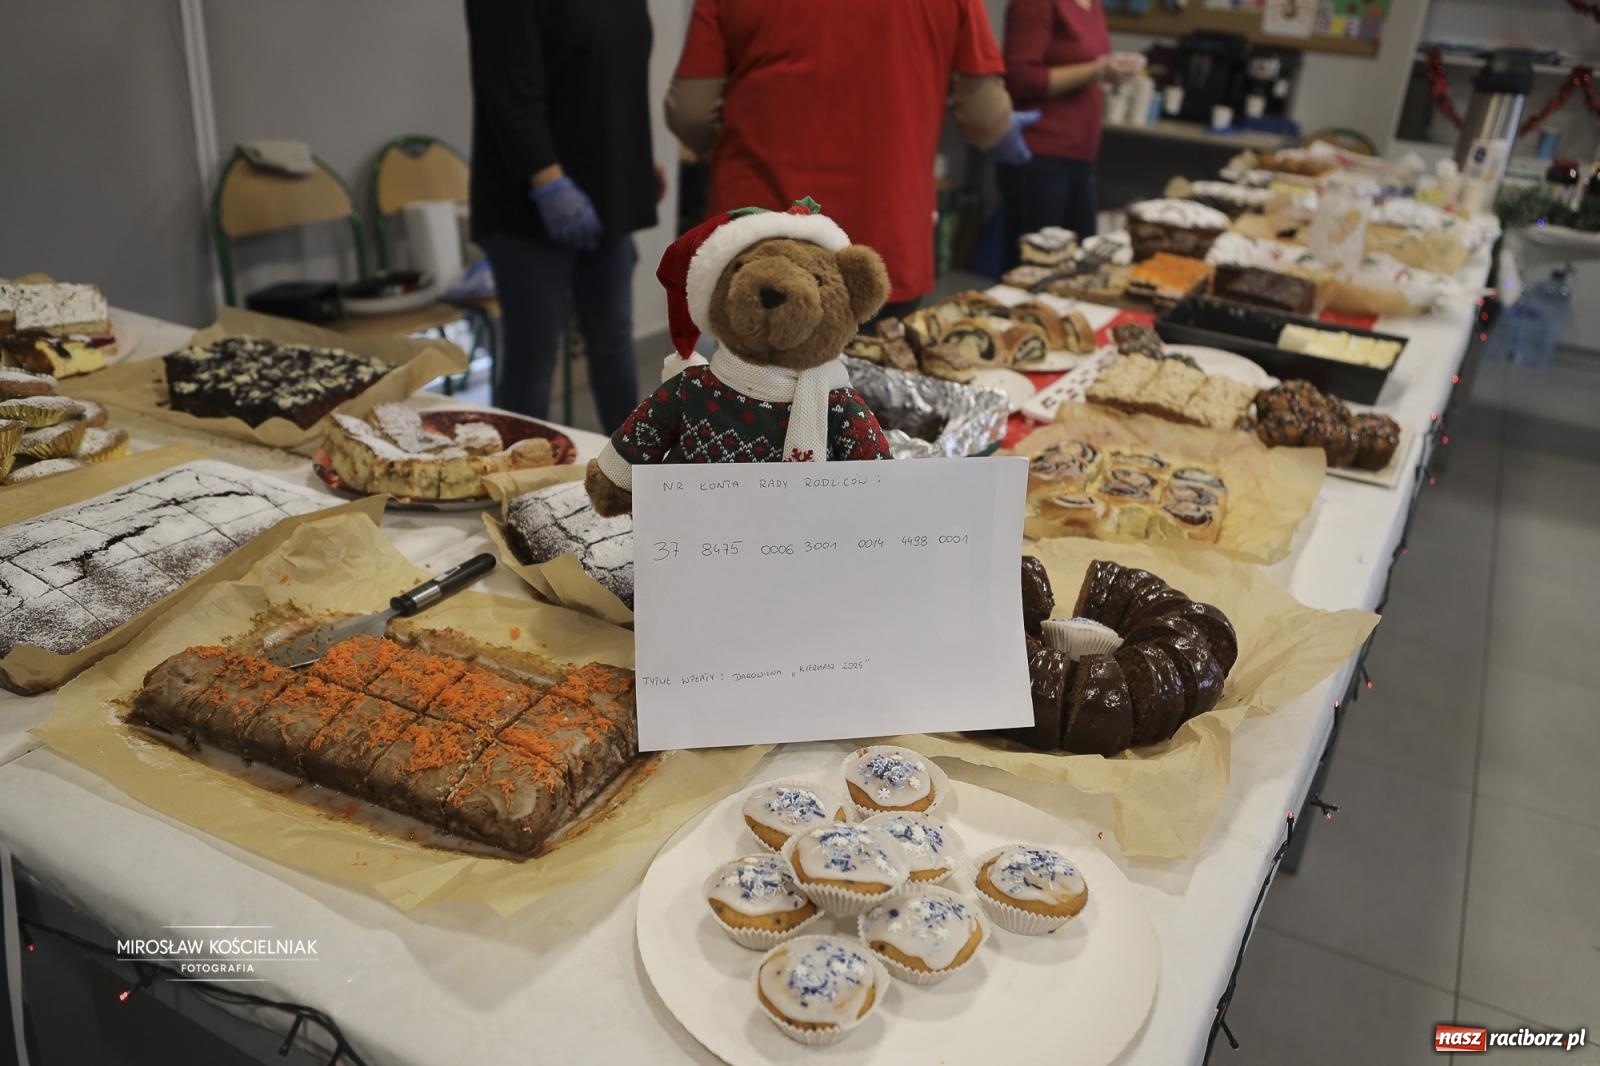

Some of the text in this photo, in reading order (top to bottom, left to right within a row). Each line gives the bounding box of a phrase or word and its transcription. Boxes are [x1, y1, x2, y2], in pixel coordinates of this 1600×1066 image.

[663, 481, 683, 491] NR
[759, 479, 788, 489] RADY
[652, 534, 968, 561] 37 8475 0006 3001 0014 4498 0001
